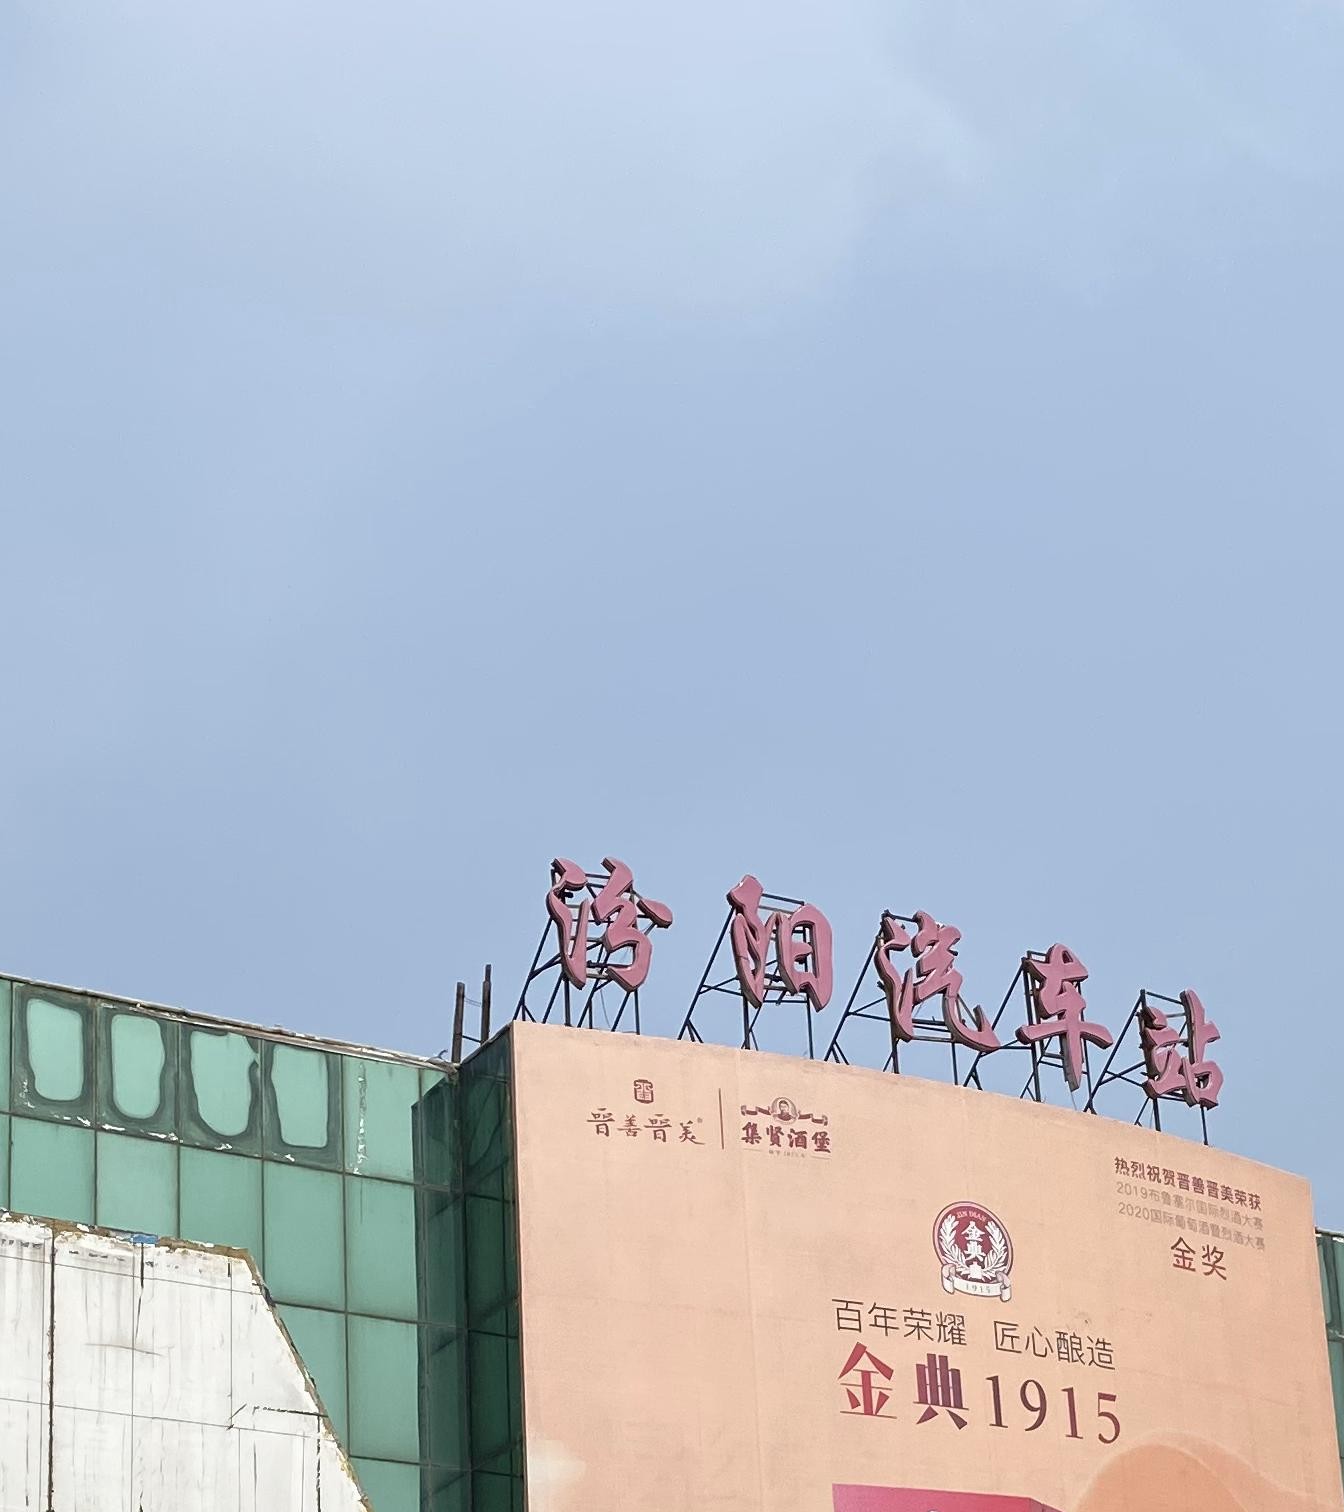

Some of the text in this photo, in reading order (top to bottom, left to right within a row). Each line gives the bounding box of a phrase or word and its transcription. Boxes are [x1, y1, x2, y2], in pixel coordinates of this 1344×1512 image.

[547, 857, 1221, 1109] 汾阳汽车站
[741, 1121, 831, 1154] 集贤酒堡
[1114, 1157, 1261, 1211] 热烈祝贺晋善晋美荣获
[1171, 1237, 1226, 1280] 金奖
[832, 1298, 1116, 1370] 百年荣耀 匠心酿造
[837, 1342, 1121, 1444] 金典1915
